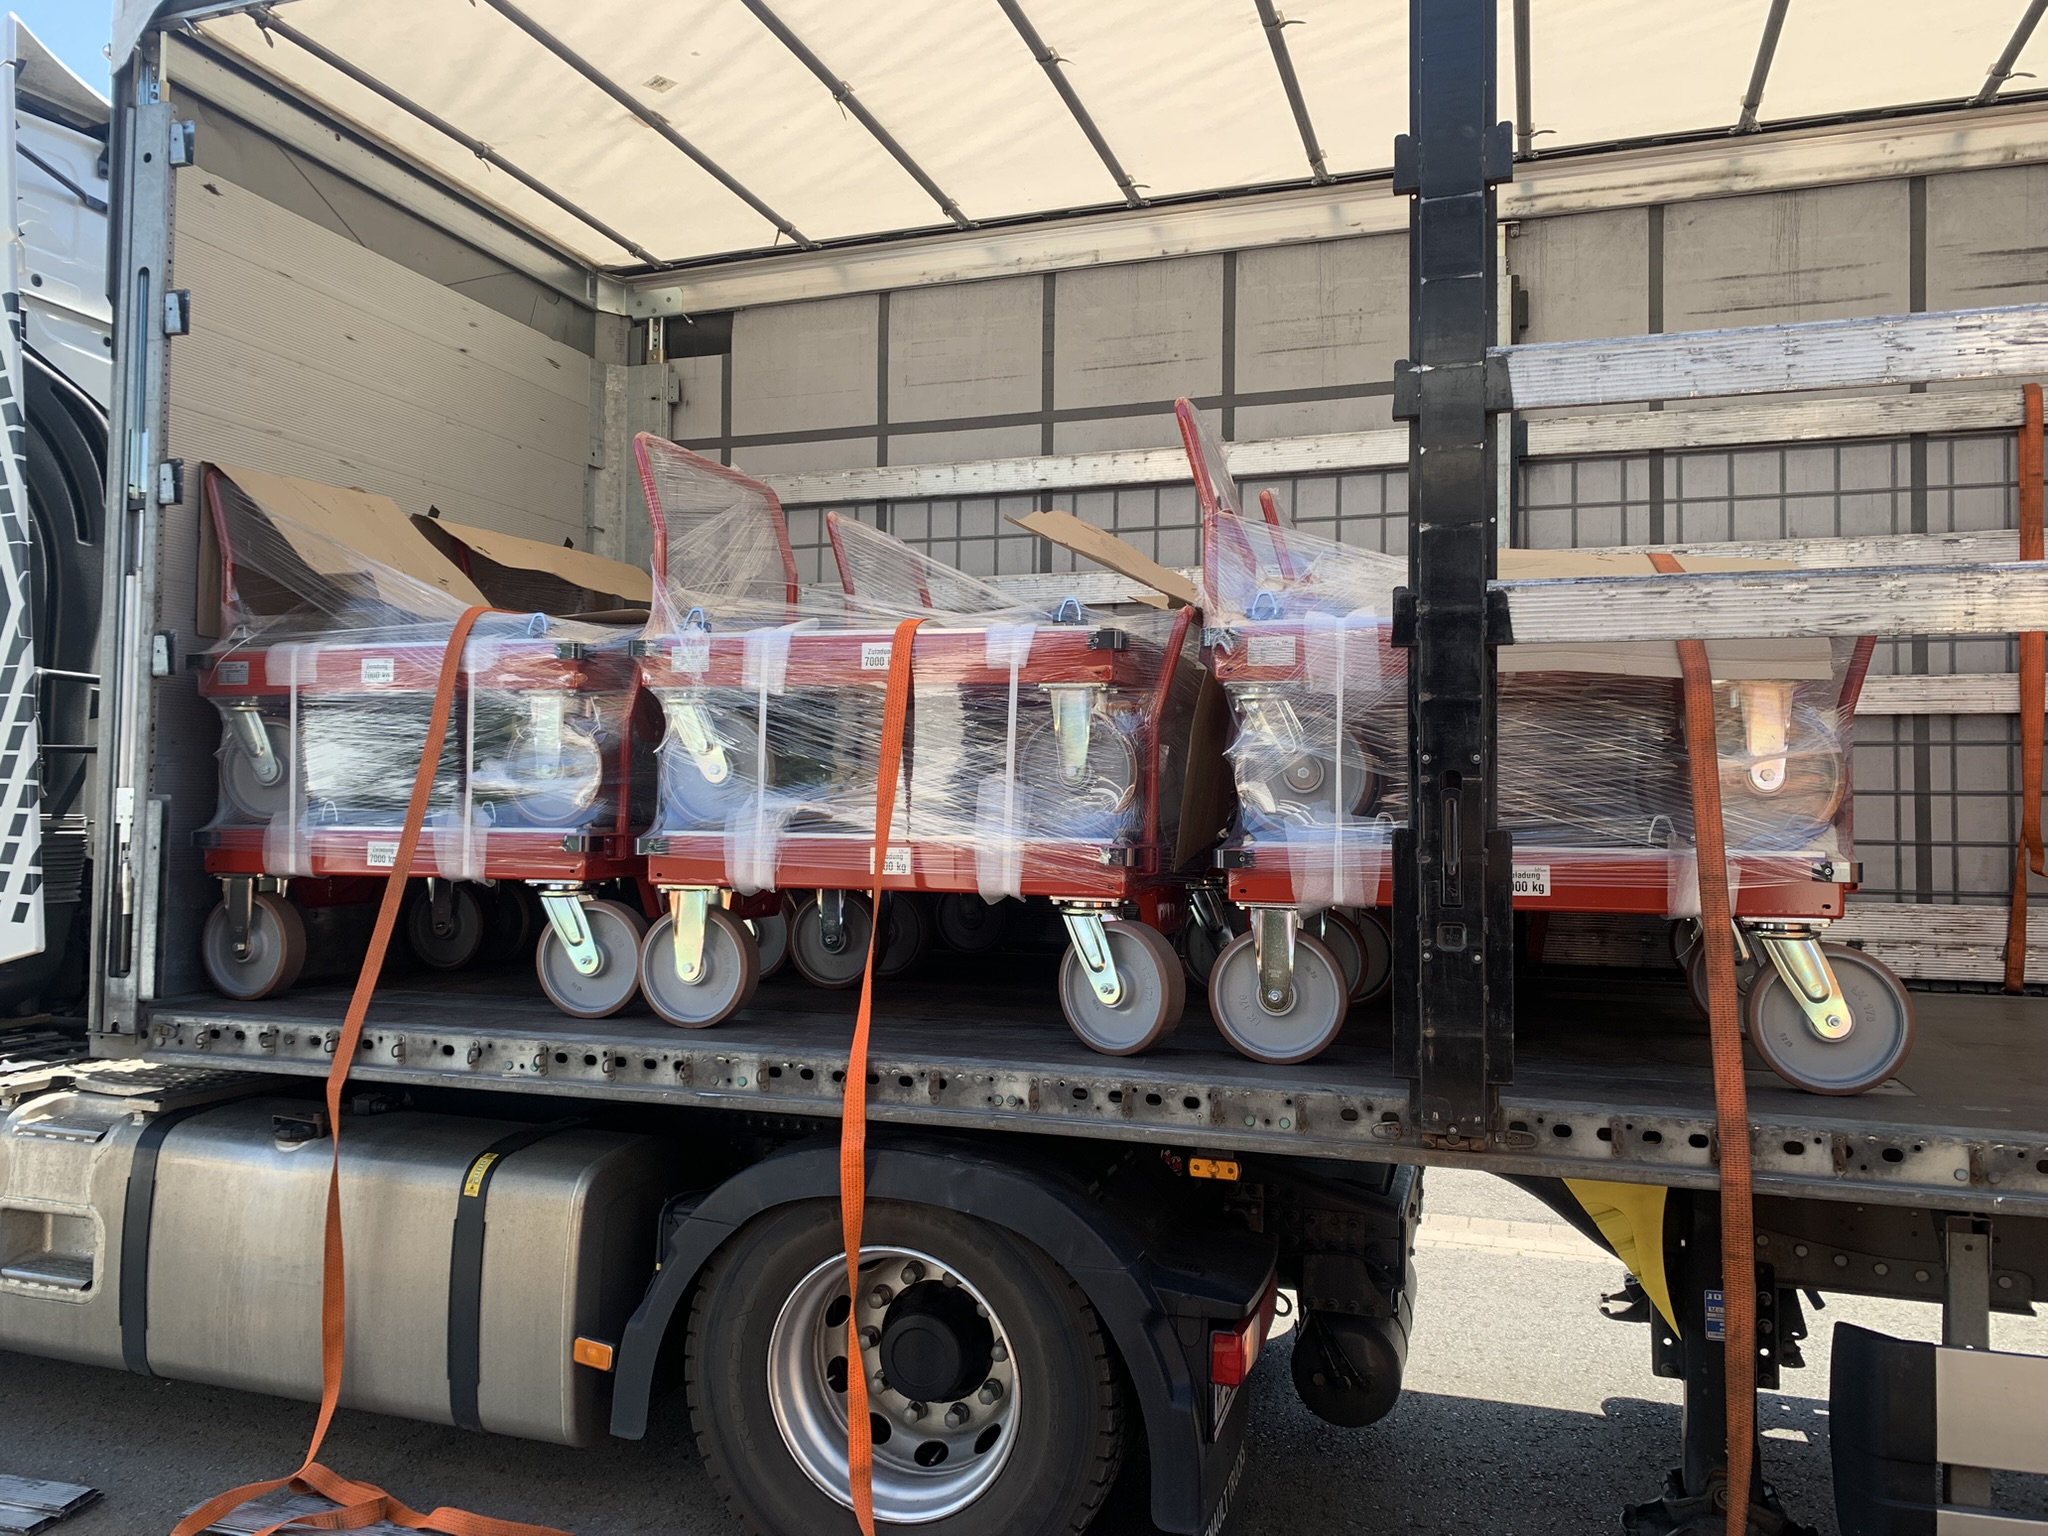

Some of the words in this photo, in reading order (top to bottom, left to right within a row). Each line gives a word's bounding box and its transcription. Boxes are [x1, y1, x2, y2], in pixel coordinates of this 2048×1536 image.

[864, 656, 884, 667] 7000
[370, 854, 386, 863] 7000
[896, 861, 907, 873] kg
[1512, 871, 1541, 880] uladung
[1532, 881, 1545, 894] kg
